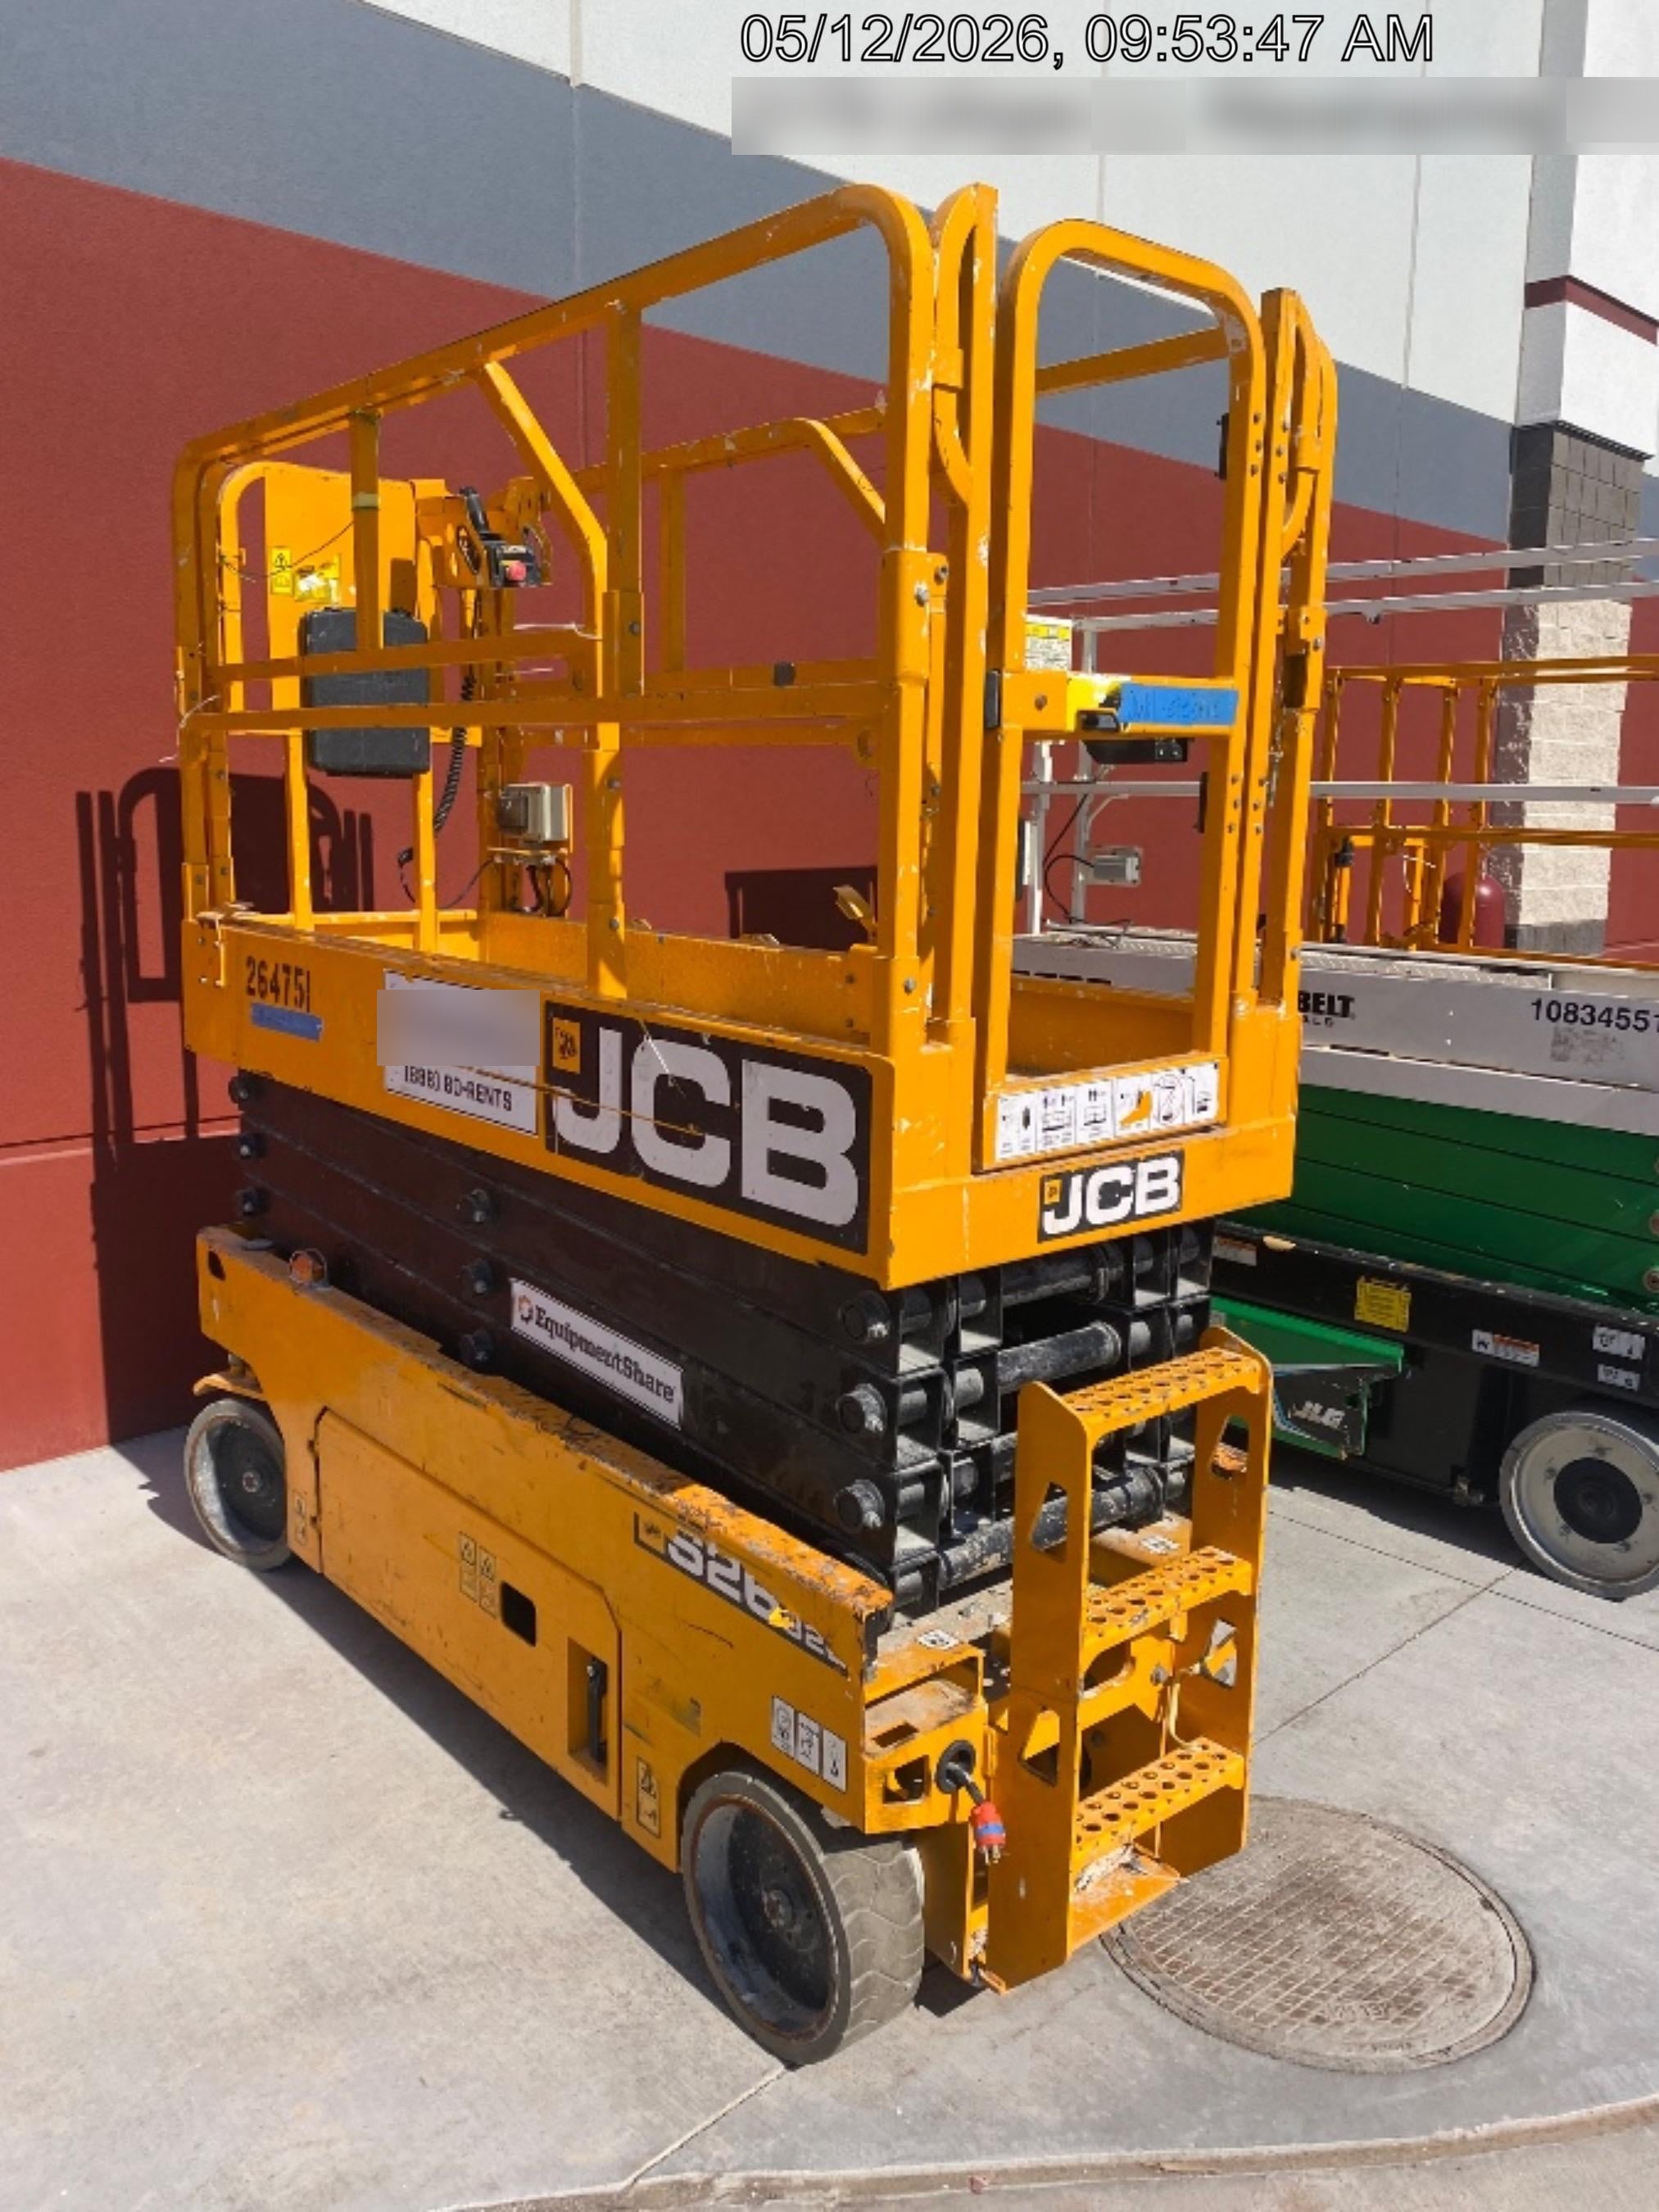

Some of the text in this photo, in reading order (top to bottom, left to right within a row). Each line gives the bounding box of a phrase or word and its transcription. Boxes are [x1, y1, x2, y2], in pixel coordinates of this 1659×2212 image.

[553, 1027, 859, 1227] JCB
[1042, 1156, 1181, 1235] JCB
[535, 1304, 676, 1403] EquipmentShare
